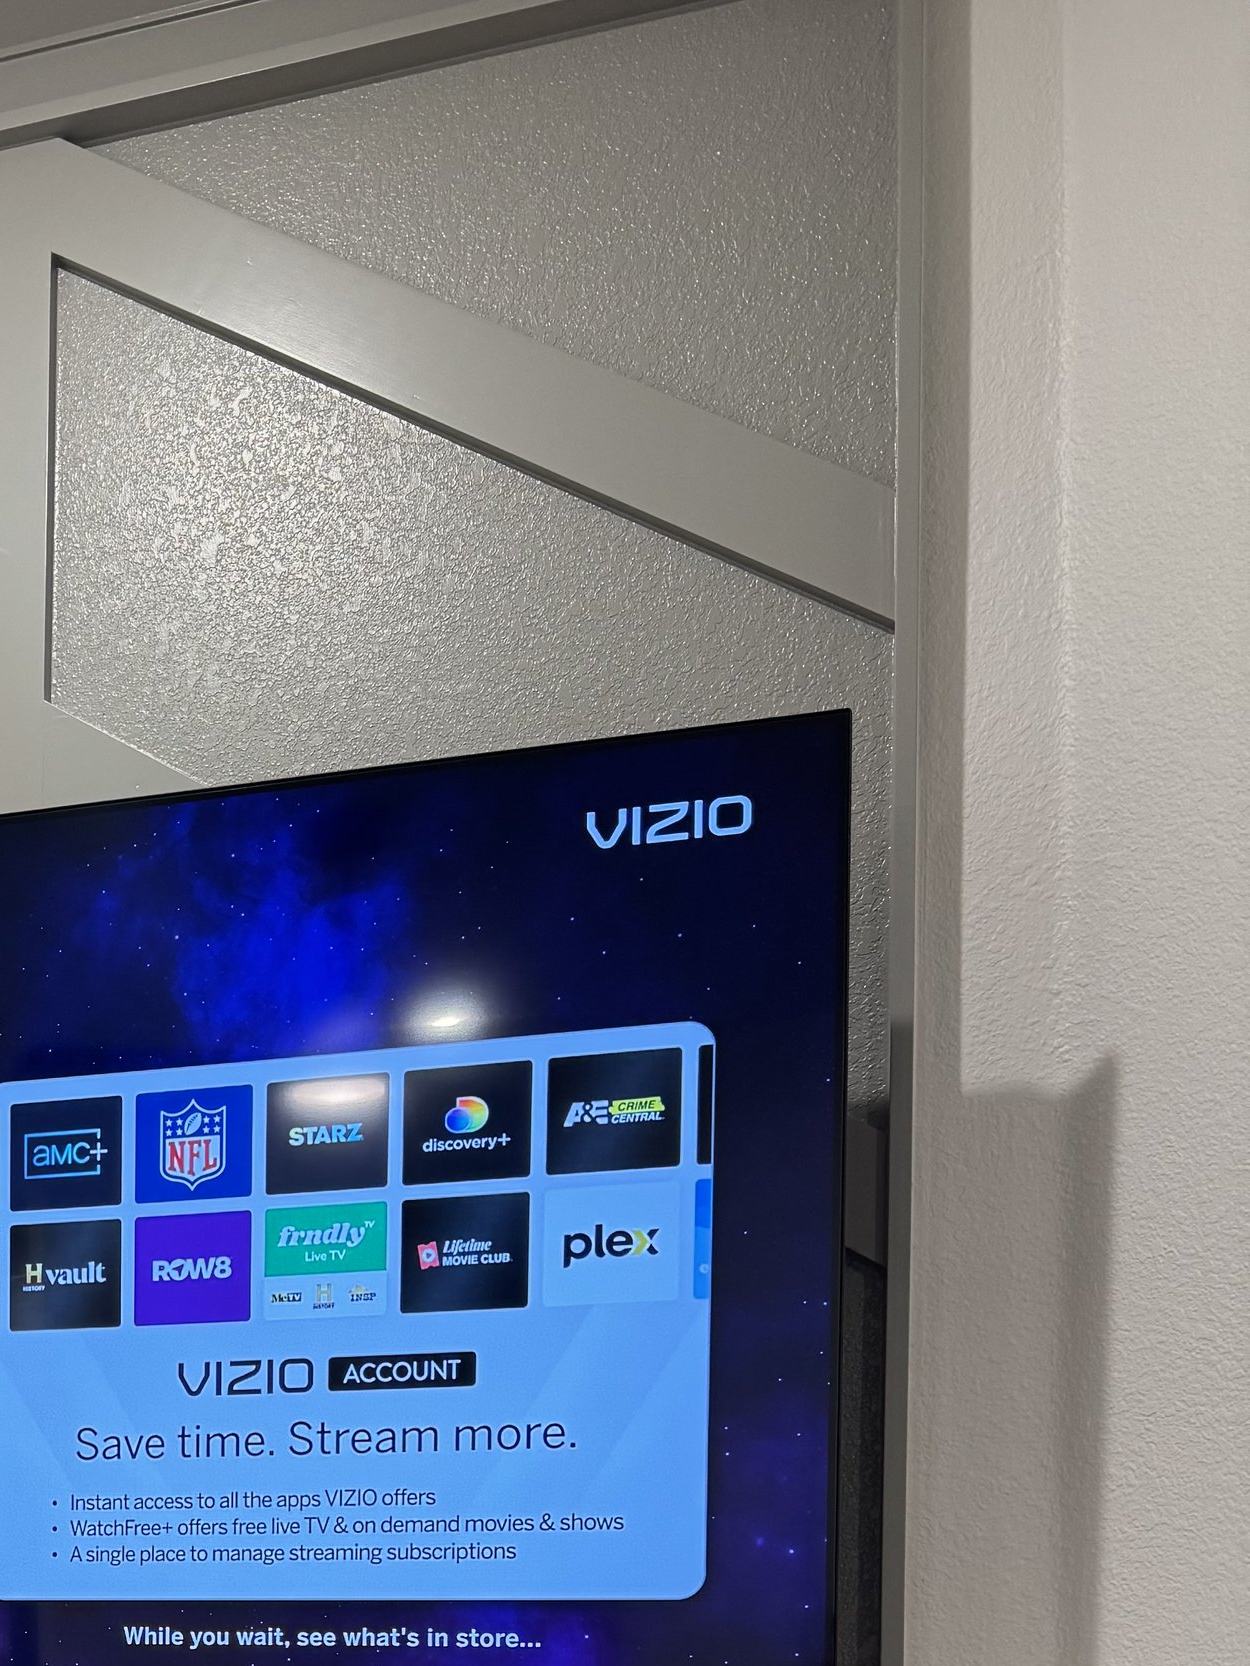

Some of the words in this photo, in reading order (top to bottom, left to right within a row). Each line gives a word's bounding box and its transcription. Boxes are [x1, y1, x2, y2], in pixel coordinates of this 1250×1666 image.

[586, 795, 752, 849] VIZIO
[563, 1100, 609, 1127] A&E
[611, 1112, 662, 1124] CENTRAL
[617, 1100, 655, 1112] CRIME
[288, 1122, 363, 1146] STARZ
[422, 1132, 511, 1153] discovery+
[168, 1138, 217, 1176] NFL
[277, 1222, 365, 1248] frndly
[442, 1239, 492, 1255] Lifetime
[563, 1224, 660, 1268] plex
[305, 1251, 327, 1262] Live
[329, 1249, 346, 1260] TV
[442, 1255, 478, 1267] MOVIE
[480, 1252, 510, 1265] CLUB
[46, 1261, 106, 1286] vault
[152, 1256, 232, 1282] ROW8
[178, 1358, 314, 1397] VIZIO
[342, 1359, 461, 1385] ACCOUNT
[76, 1427, 165, 1461] Save
[177, 1424, 274, 1459] time.
[288, 1420, 439, 1457] Stream
[454, 1422, 577, 1453] more.
[70, 1493, 130, 1511] Instant
[133, 1496, 193, 1510] access
[197, 1493, 215, 1509] to
[219, 1491, 238, 1509] all
[243, 1491, 272, 1508] the
[276, 1494, 321, 1512] apps
[324, 1489, 377, 1507] VIZIO
[382, 1488, 436, 1506] offers
[70, 1518, 173, 1537] WatchFree+
[177, 1517, 228, 1535] offers
[231, 1517, 267, 1535] free
[271, 1517, 300, 1534] live
[303, 1516, 330, 1534] TV
[333, 1516, 349, 1533] &
[352, 1519, 376, 1533] on
[381, 1515, 460, 1533] demand
[464, 1514, 534, 1532] movies
[539, 1513, 556, 1531] &
[559, 1512, 624, 1531] shows
[70, 1546, 82, 1562] A
[86, 1545, 136, 1566] single
[140, 1545, 186, 1566] place
[190, 1546, 208, 1562] to
[212, 1548, 285, 1565] manage
[289, 1544, 382, 1564] streaming
[386, 1542, 517, 1563] subscriptions
[123, 1626, 183, 1646] While
[189, 1631, 230, 1650] you
[236, 1627, 290, 1648] wait,
[296, 1632, 336, 1647] see
[343, 1627, 419, 1647] what's
[427, 1628, 448, 1647] in
[455, 1628, 542, 1648] store...
